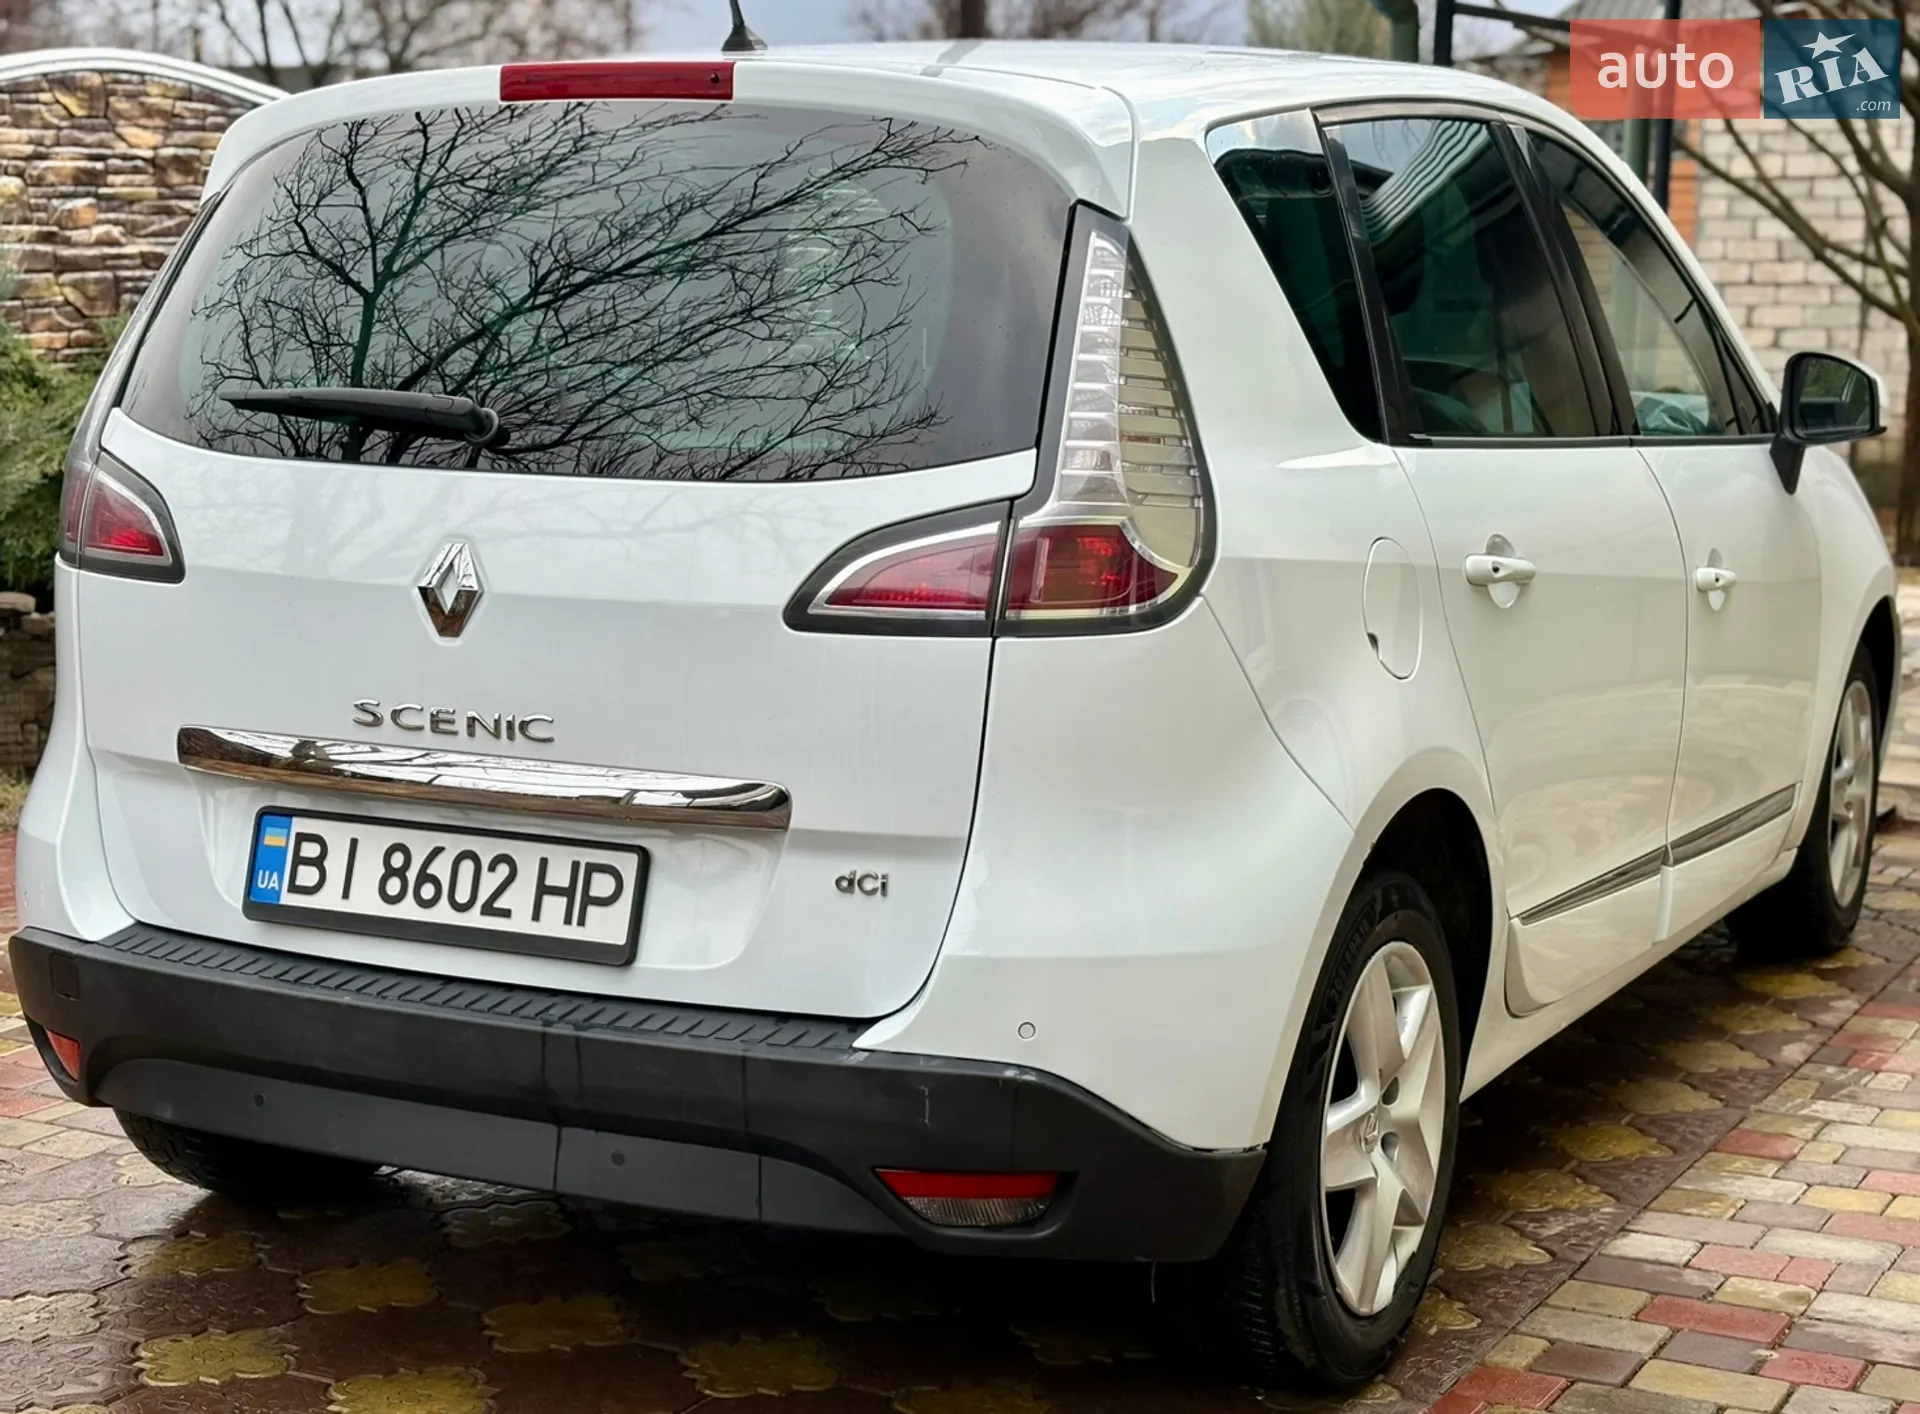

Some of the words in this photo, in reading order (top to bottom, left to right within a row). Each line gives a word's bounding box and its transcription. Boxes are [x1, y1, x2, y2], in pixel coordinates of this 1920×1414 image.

[353, 699, 554, 743] SCENIC
[257, 870, 280, 891] UA
[287, 832, 358, 900] BI
[377, 842, 518, 919] 8602
[531, 856, 625, 927] HP
[834, 869, 889, 898] dCi
